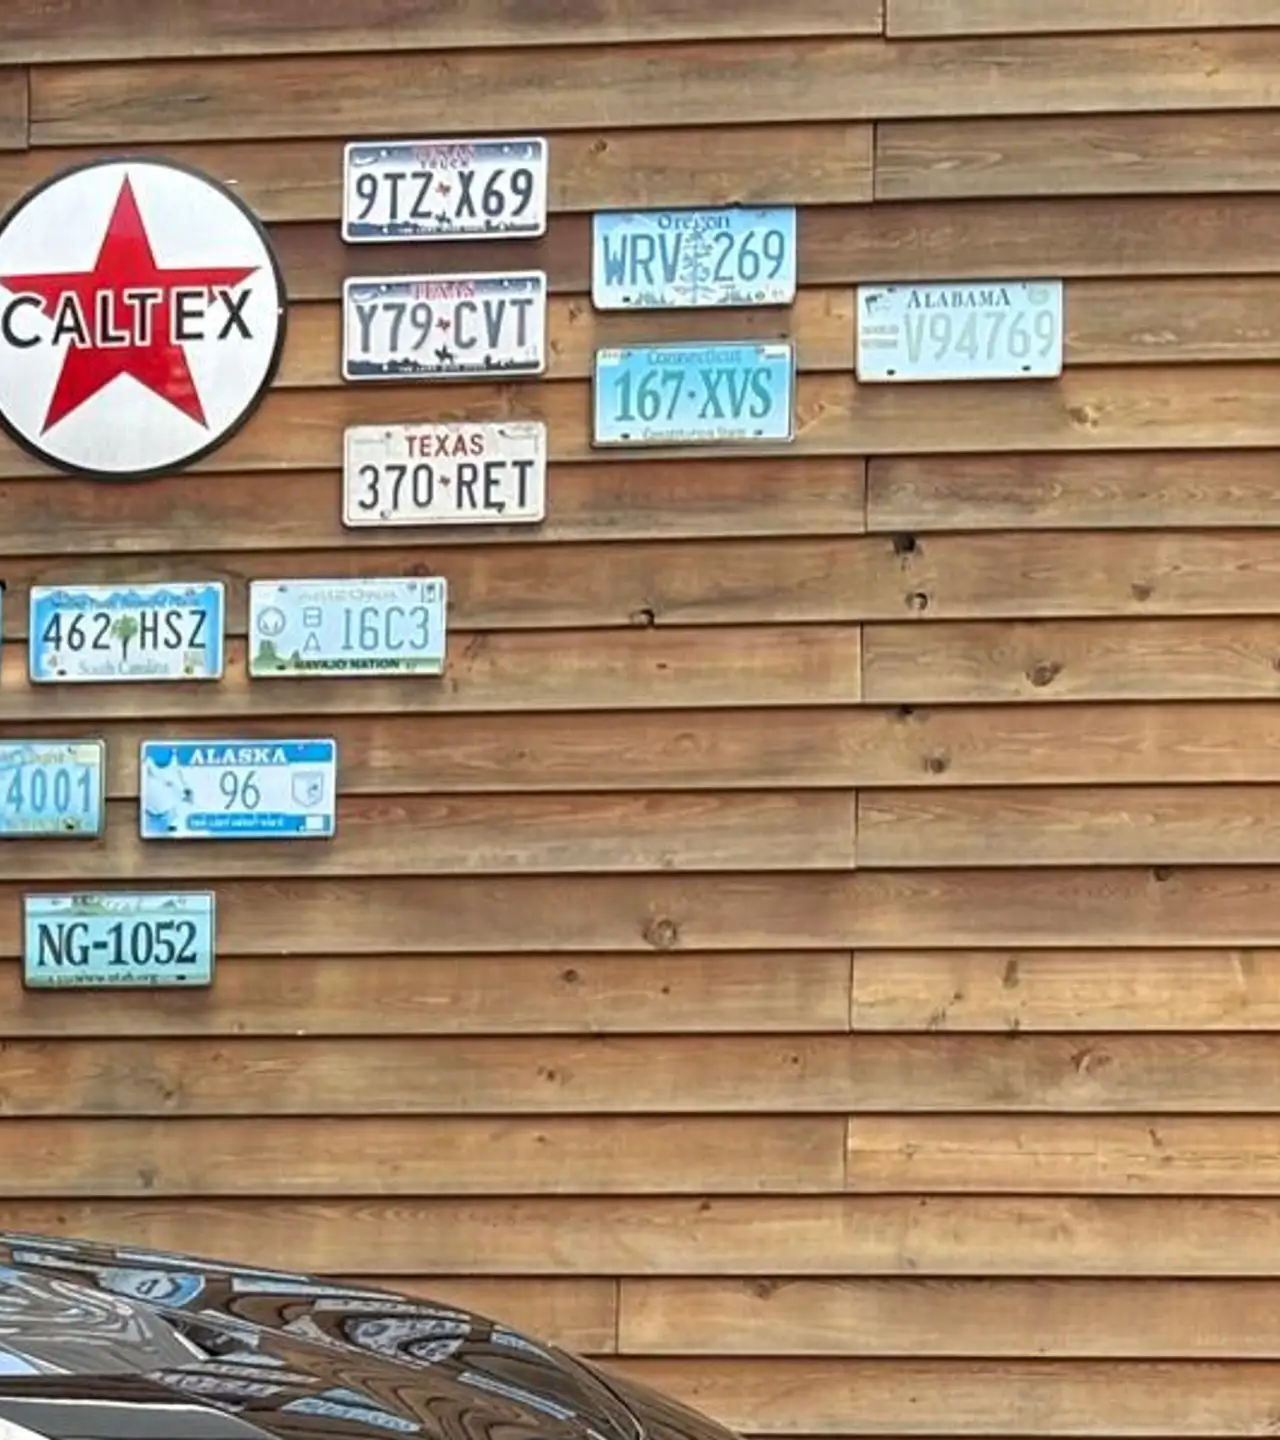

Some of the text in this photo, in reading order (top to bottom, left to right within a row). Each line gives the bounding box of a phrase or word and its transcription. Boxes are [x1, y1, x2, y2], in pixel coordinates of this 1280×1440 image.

[356, 168, 534, 219] 9TZ X69
[657, 214, 730, 232] Oregon
[603, 230, 785, 286] WRV 269
[1, 288, 254, 349] CALTEX
[908, 288, 1011, 308] ALABAMA
[356, 298, 534, 353] Y79 CVT
[903, 309, 1055, 363] V94769
[405, 433, 485, 458] TEXAS
[358, 459, 534, 511] 370 RET
[42, 610, 207, 651] 462 HSZ
[294, 657, 400, 670] NAVAJO NATION
[191, 747, 287, 765] ALASKA
[219, 769, 261, 810] 96
[37, 919, 197, 967] NG-1052
